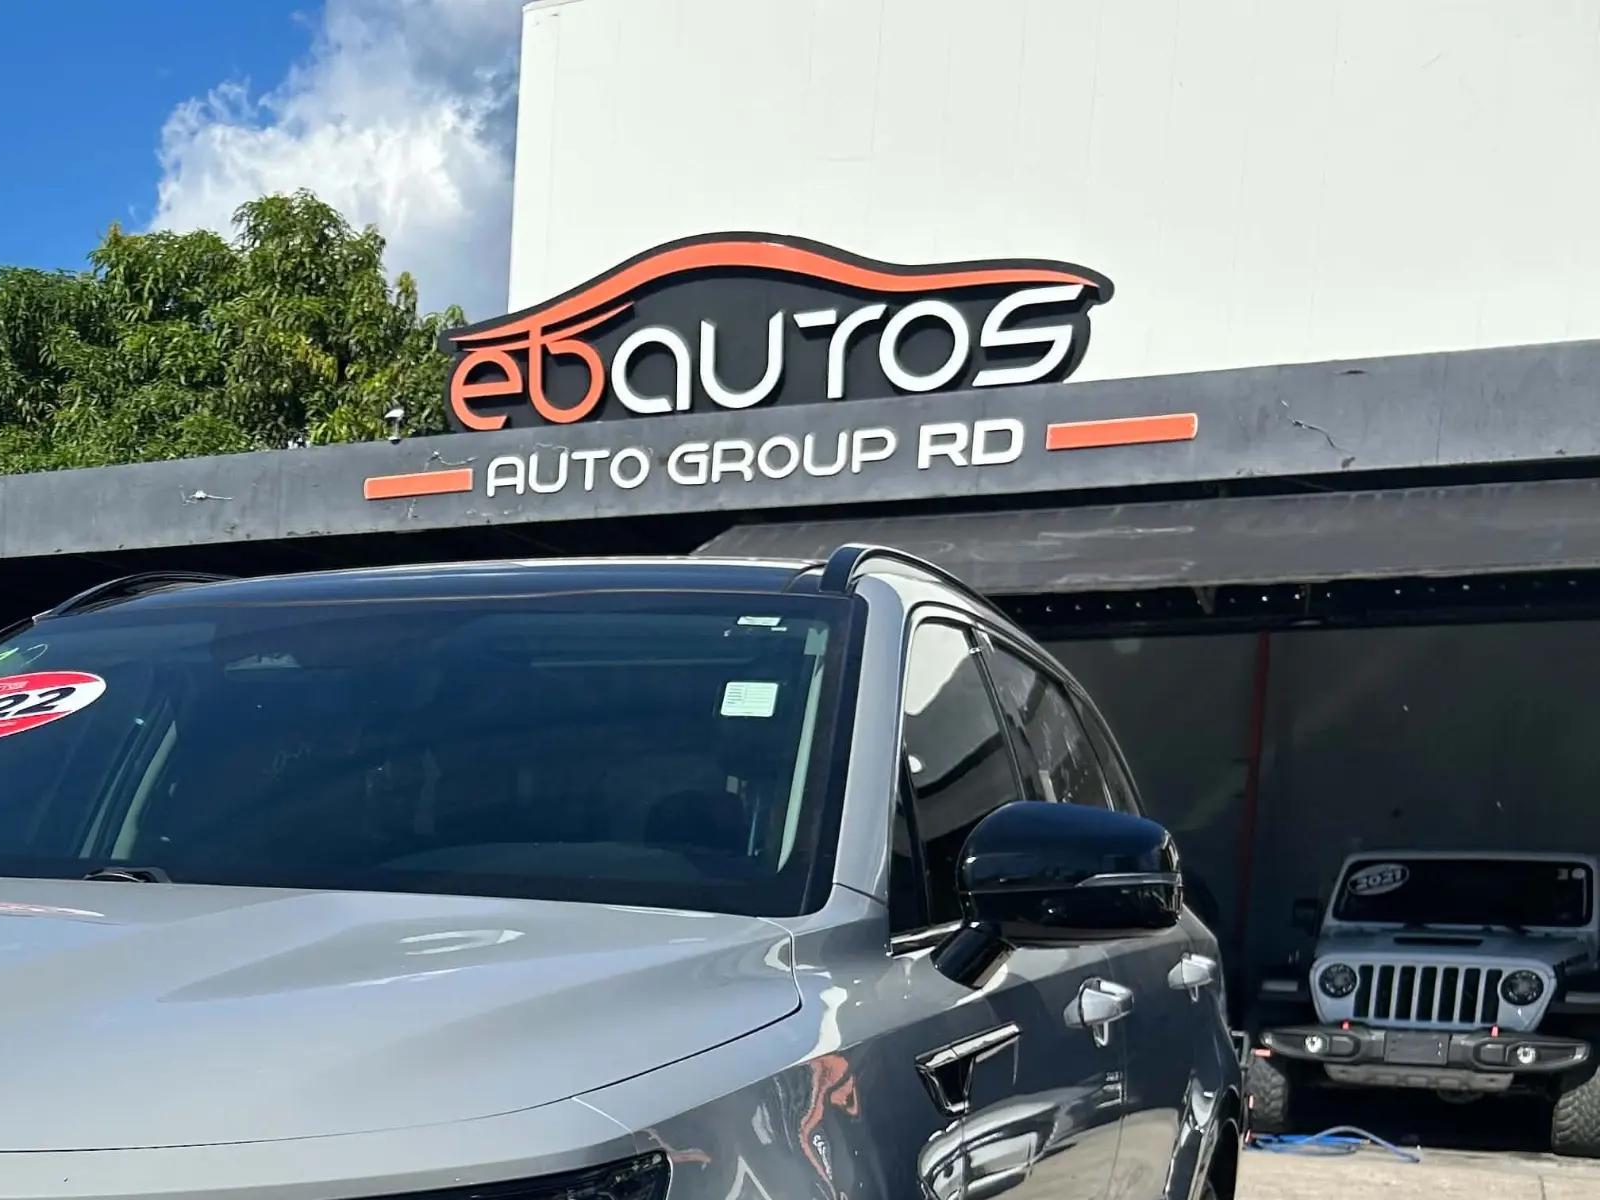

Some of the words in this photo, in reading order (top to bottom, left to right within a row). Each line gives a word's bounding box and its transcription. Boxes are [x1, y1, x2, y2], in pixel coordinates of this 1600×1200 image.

[486, 445, 650, 498] AUTO
[667, 425, 898, 488] GROUP
[917, 417, 1024, 470] RD
